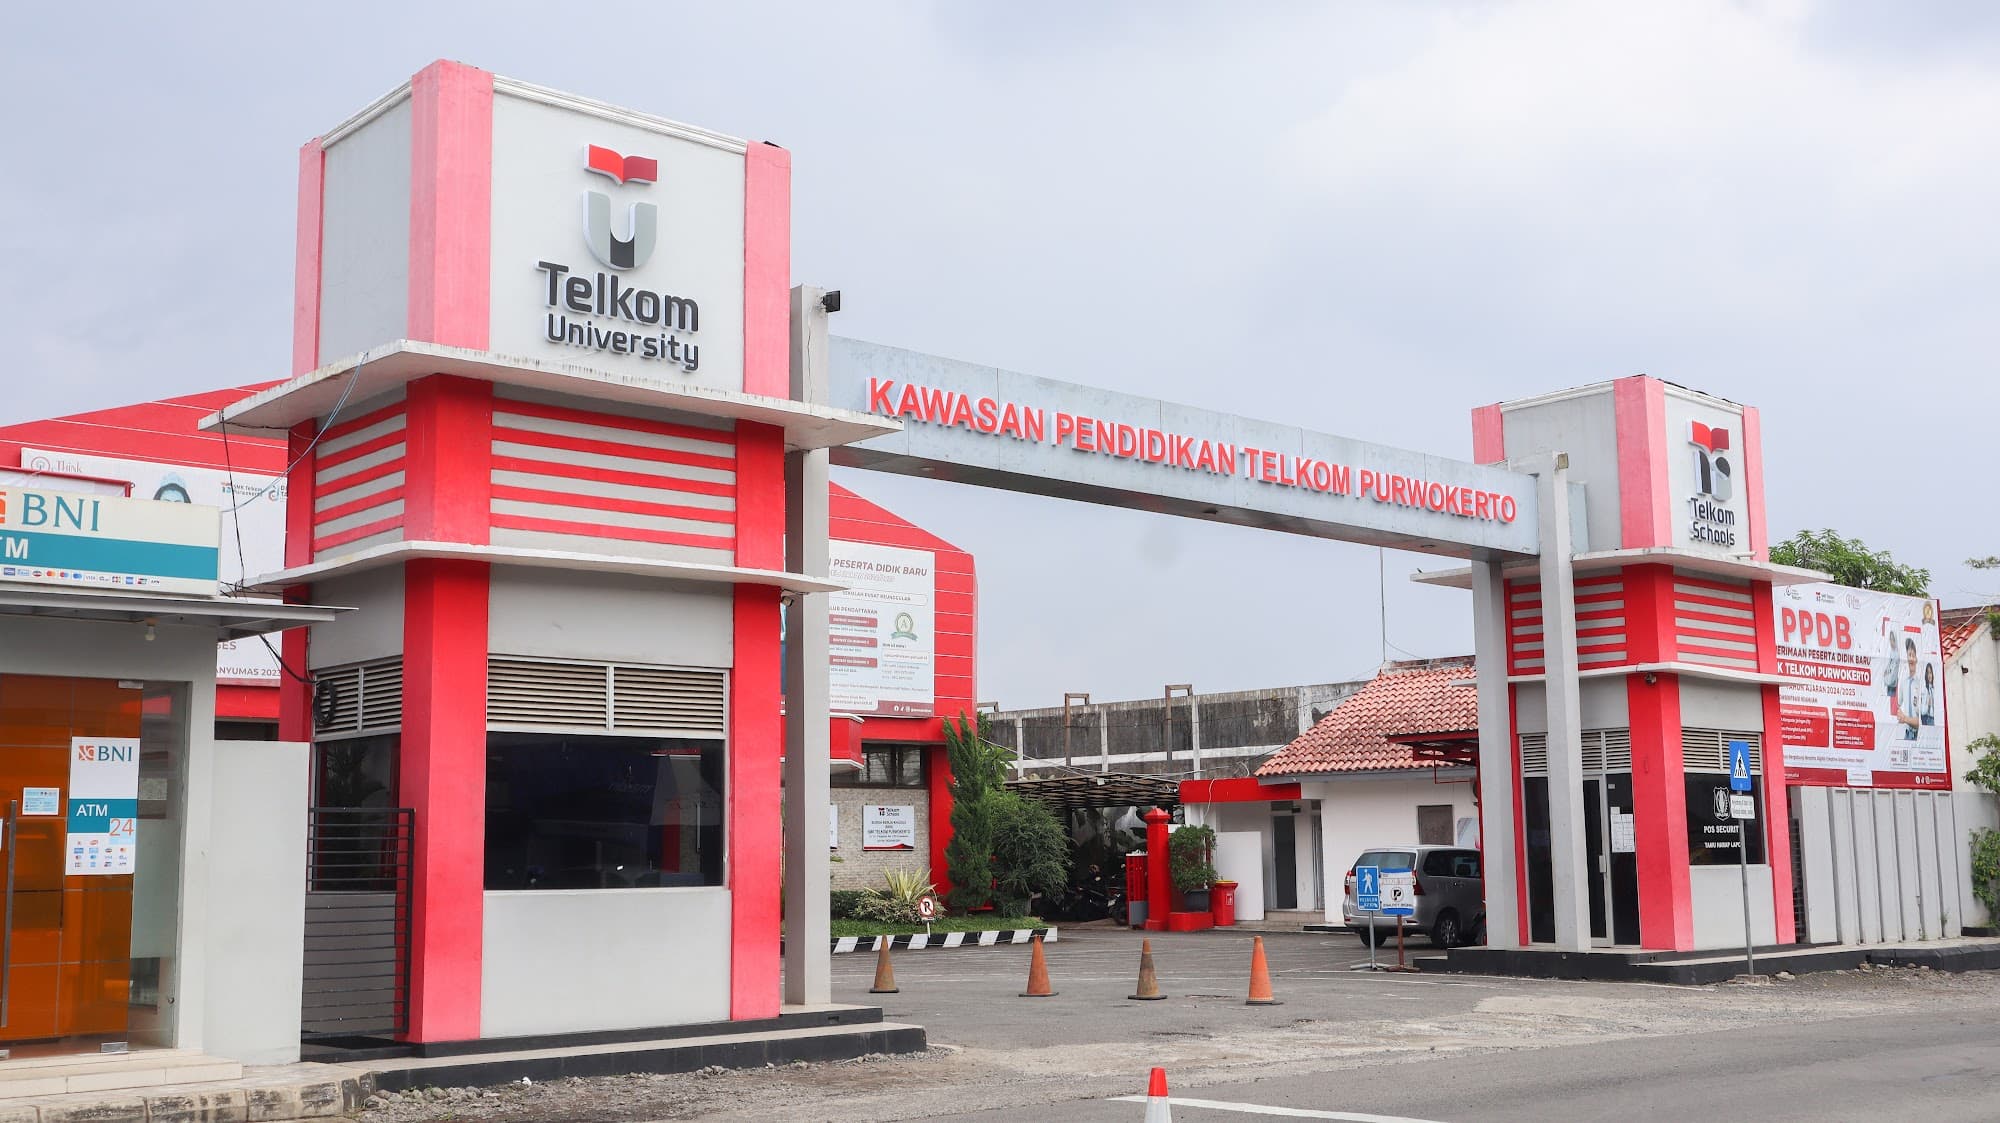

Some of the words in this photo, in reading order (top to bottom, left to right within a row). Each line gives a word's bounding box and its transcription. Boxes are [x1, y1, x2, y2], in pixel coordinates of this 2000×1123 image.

[536, 260, 699, 333] Telkom
[546, 313, 699, 372] University
[868, 376, 1044, 442] KAWASAN
[1055, 411, 1235, 476] PENDIDIKAN
[1243, 447, 1351, 496] TELKOM
[1359, 469, 1517, 523] PURWOKERTO
[21, 493, 101, 532] BNI
[1690, 497, 1735, 526] Telkom
[1692, 521, 1736, 546] Schools
[0, 535, 29, 560] M
[833, 558, 874, 571] PESERTA
[875, 563, 901, 575] DIDIK
[902, 565, 928, 577] BARU
[1781, 607, 1852, 650] PPDB
[1776, 645, 1807, 658] ERIMAAN
[1808, 649, 1835, 662] PESERTA
[1837, 653, 1856, 663] DIDIK
[1855, 655, 1872, 666] BARU
[1785, 663, 1817, 678] TELKOM
[1818, 666, 1870, 683] PURWOKERTO
[1827, 687, 1856, 697] 2024/2025
[98, 745, 133, 762] BNI
[76, 804, 108, 817] ATM
[109, 818, 135, 837] 24
[1703, 825, 1715, 834] POS
[1715, 825, 1740, 834] SECURIT
